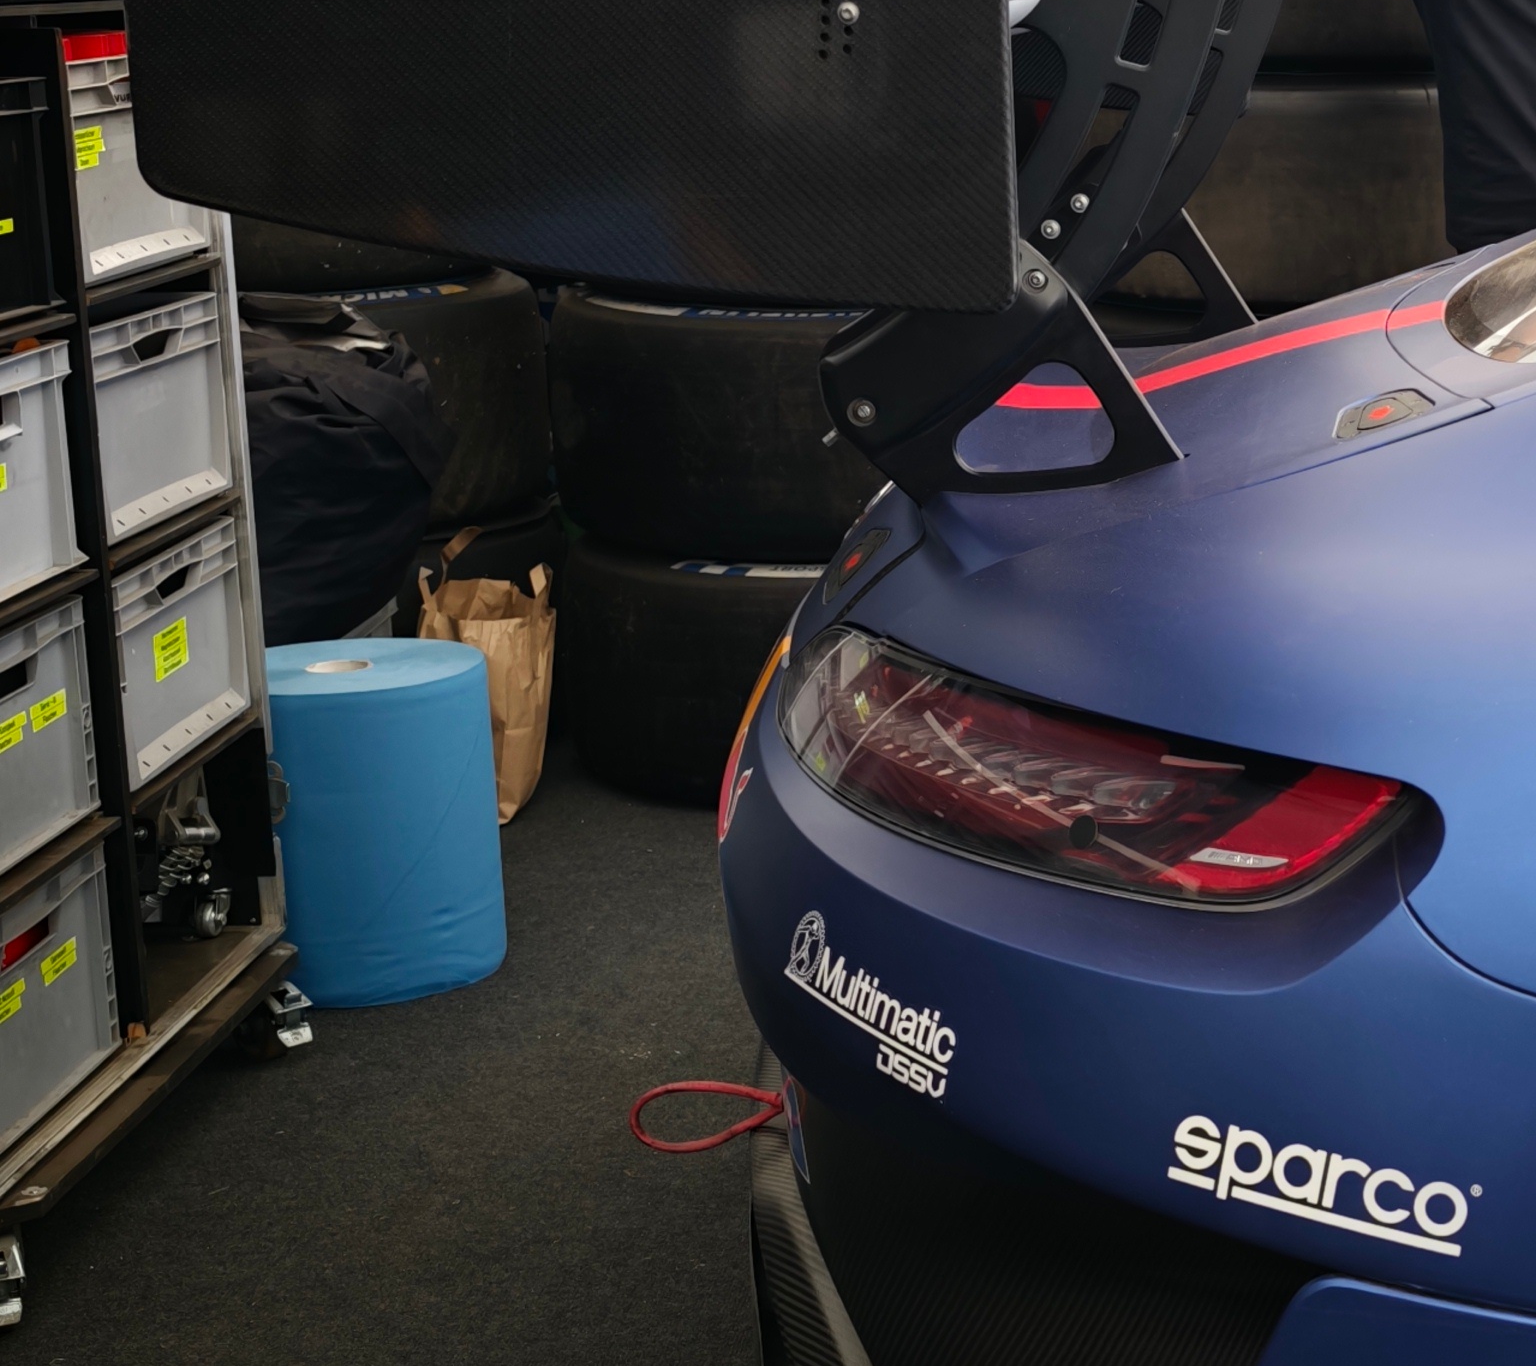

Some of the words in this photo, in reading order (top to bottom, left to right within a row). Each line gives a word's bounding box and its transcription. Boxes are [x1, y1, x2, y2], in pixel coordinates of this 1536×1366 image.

[814, 945, 957, 1064] Multimatic
[876, 1043, 947, 1099] DSSV
[1173, 1114, 1469, 1238] sparco
